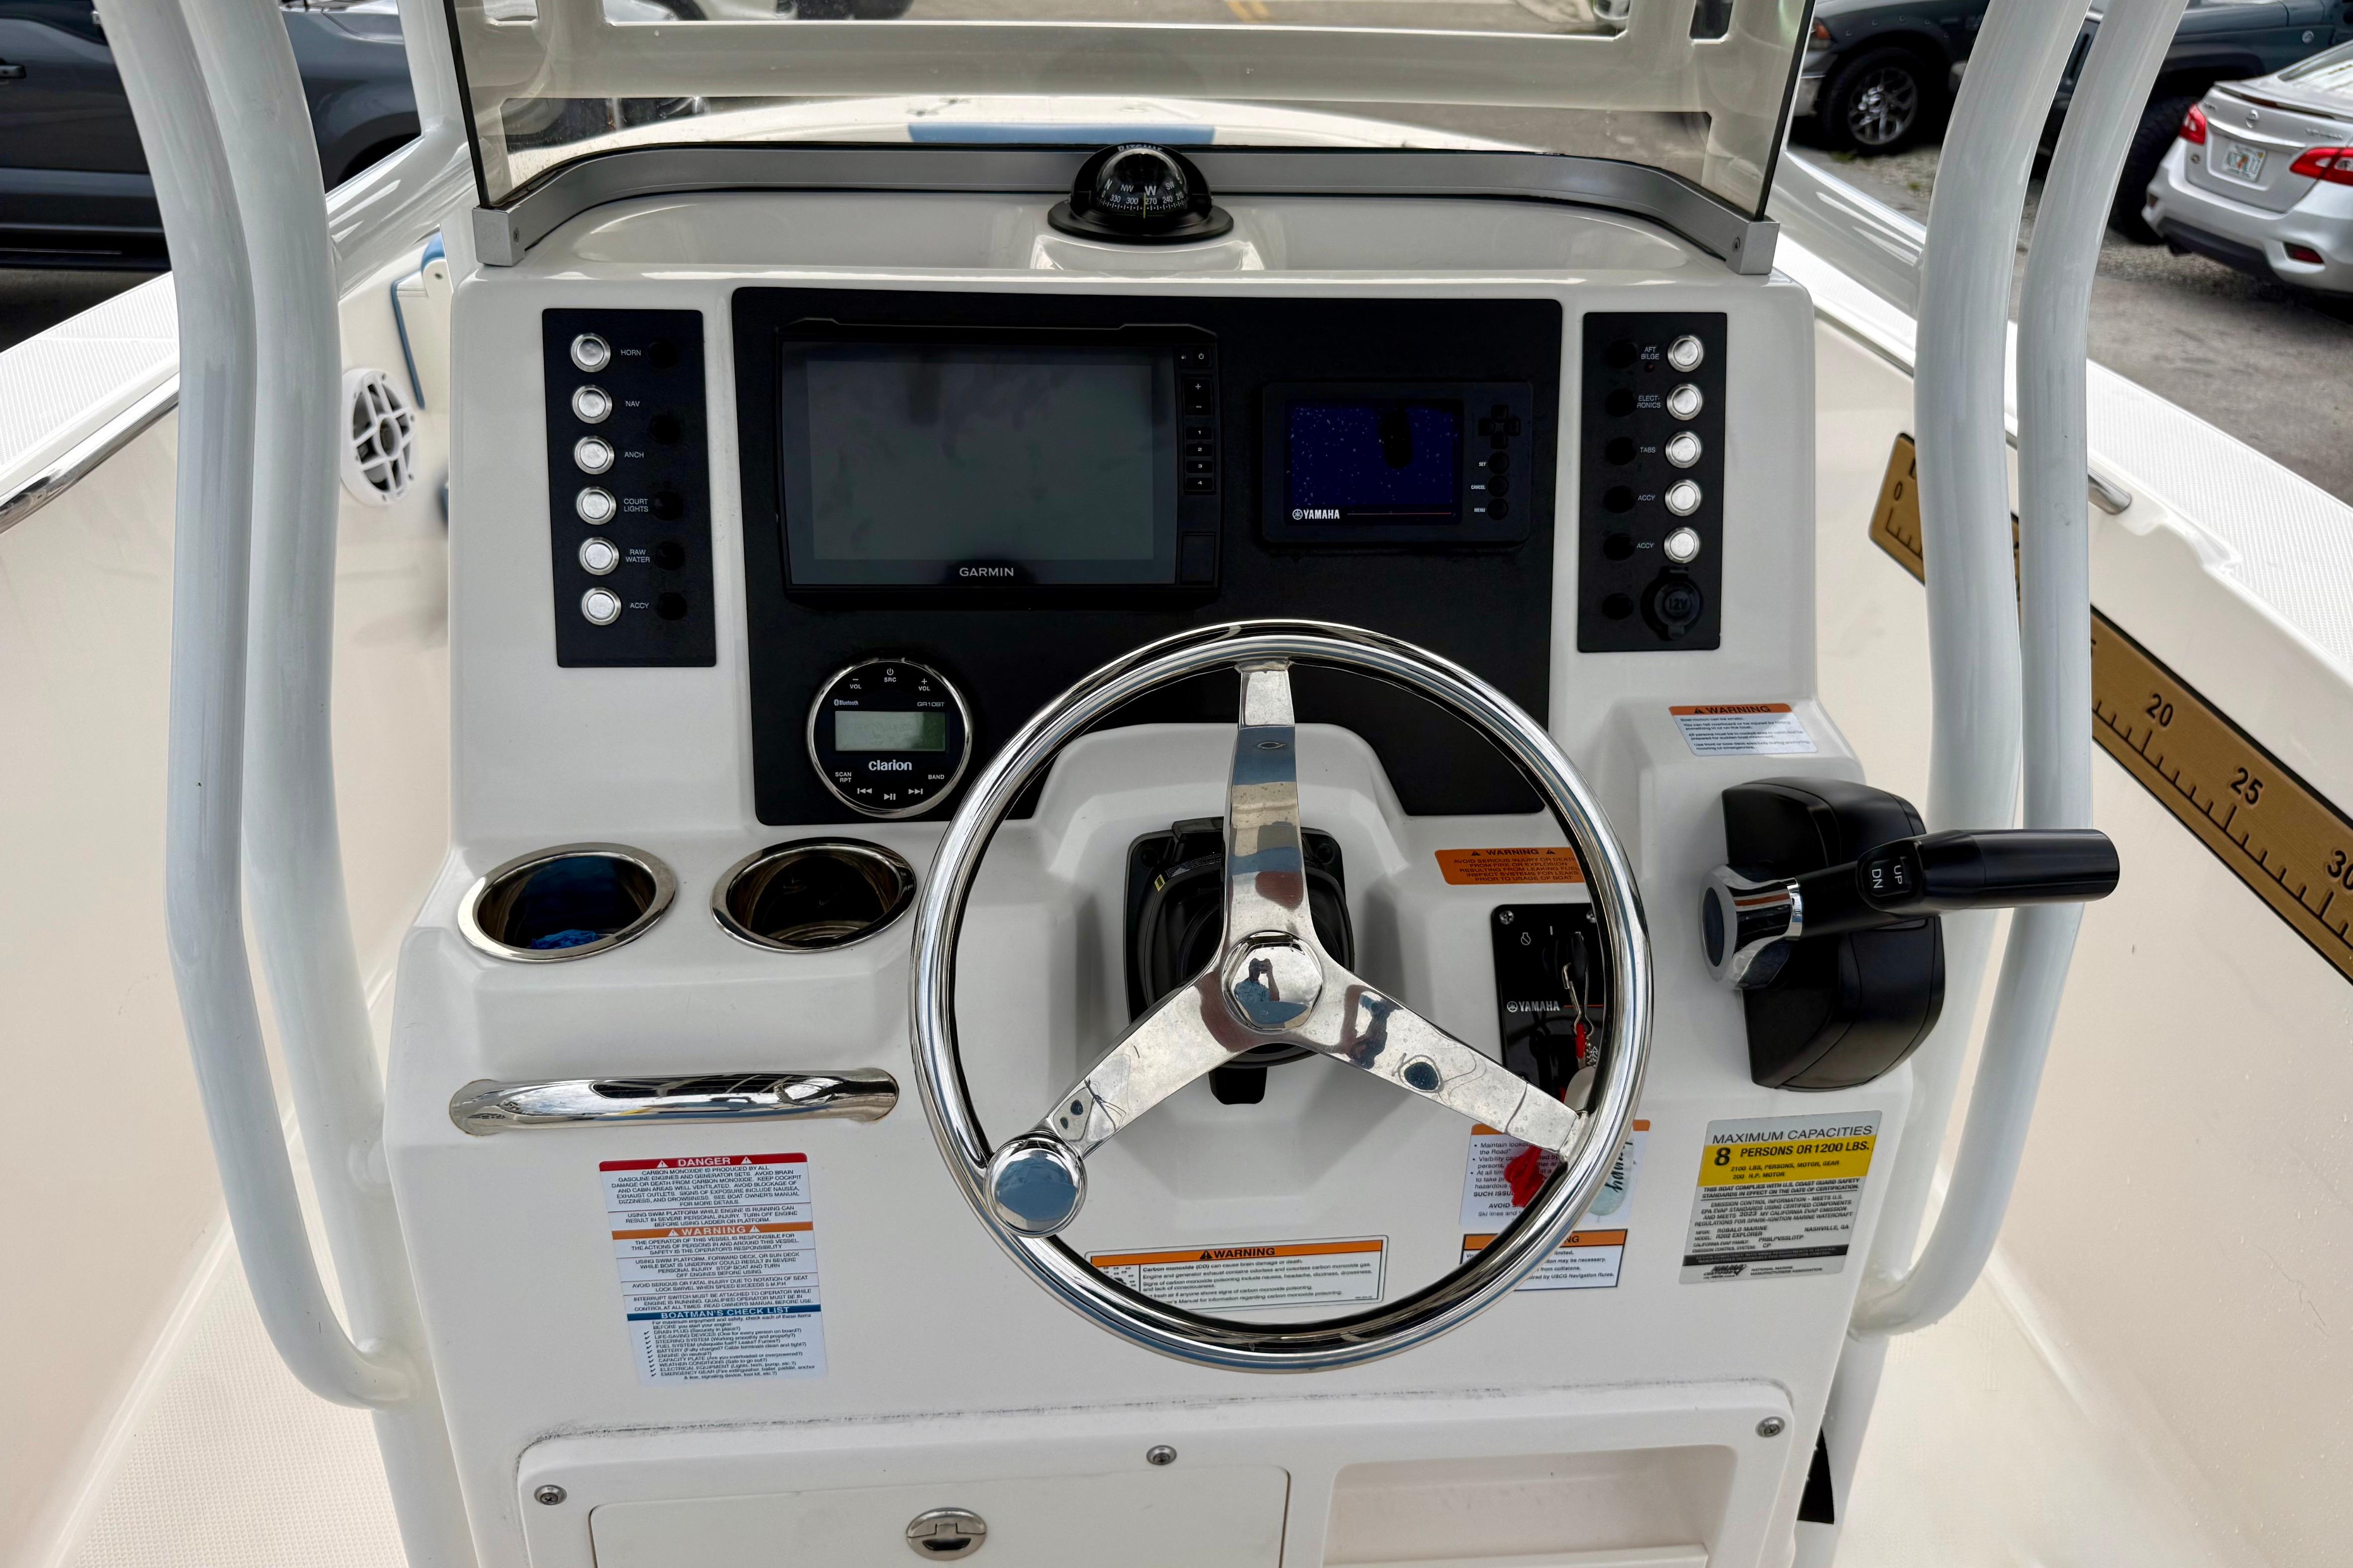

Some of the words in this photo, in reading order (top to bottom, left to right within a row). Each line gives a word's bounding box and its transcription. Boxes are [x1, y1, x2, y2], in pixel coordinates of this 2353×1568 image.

[1105, 179, 1113, 190] N
[1145, 186, 1156, 196] W
[1165, 181, 1175, 190] SW
[1110, 195, 1121, 203] 330
[1894, 482, 1903, 500] 0
[1303, 509, 1340, 519] YAMAHA
[959, 568, 1014, 577] GARMIN
[1669, 598, 1688, 610] 12V
[2146, 693, 2174, 727] 20
[2230, 767, 2264, 805] 25
[1872, 869, 1883, 888] DN
[1894, 865, 1902, 884] UP
[1519, 1000, 1560, 1011] YAMAHA
[1713, 1131, 1783, 1144] MAXIMUM
[1787, 1126, 1872, 1140] CAPACITIES
[1741, 1146, 1794, 1157] PERSONS
[1796, 1144, 1813, 1154] OR
[1814, 1143, 1843, 1153] 1200
[1844, 1141, 1869, 1151] LBS.
[678, 1157, 730, 1167] DANGER
[1714, 1148, 1731, 1165] 8
[683, 1226, 744, 1236] WARNING
[1214, 1248, 1275, 1258] WARNING
[662, 1310, 723, 1319] BOATMAN'S
